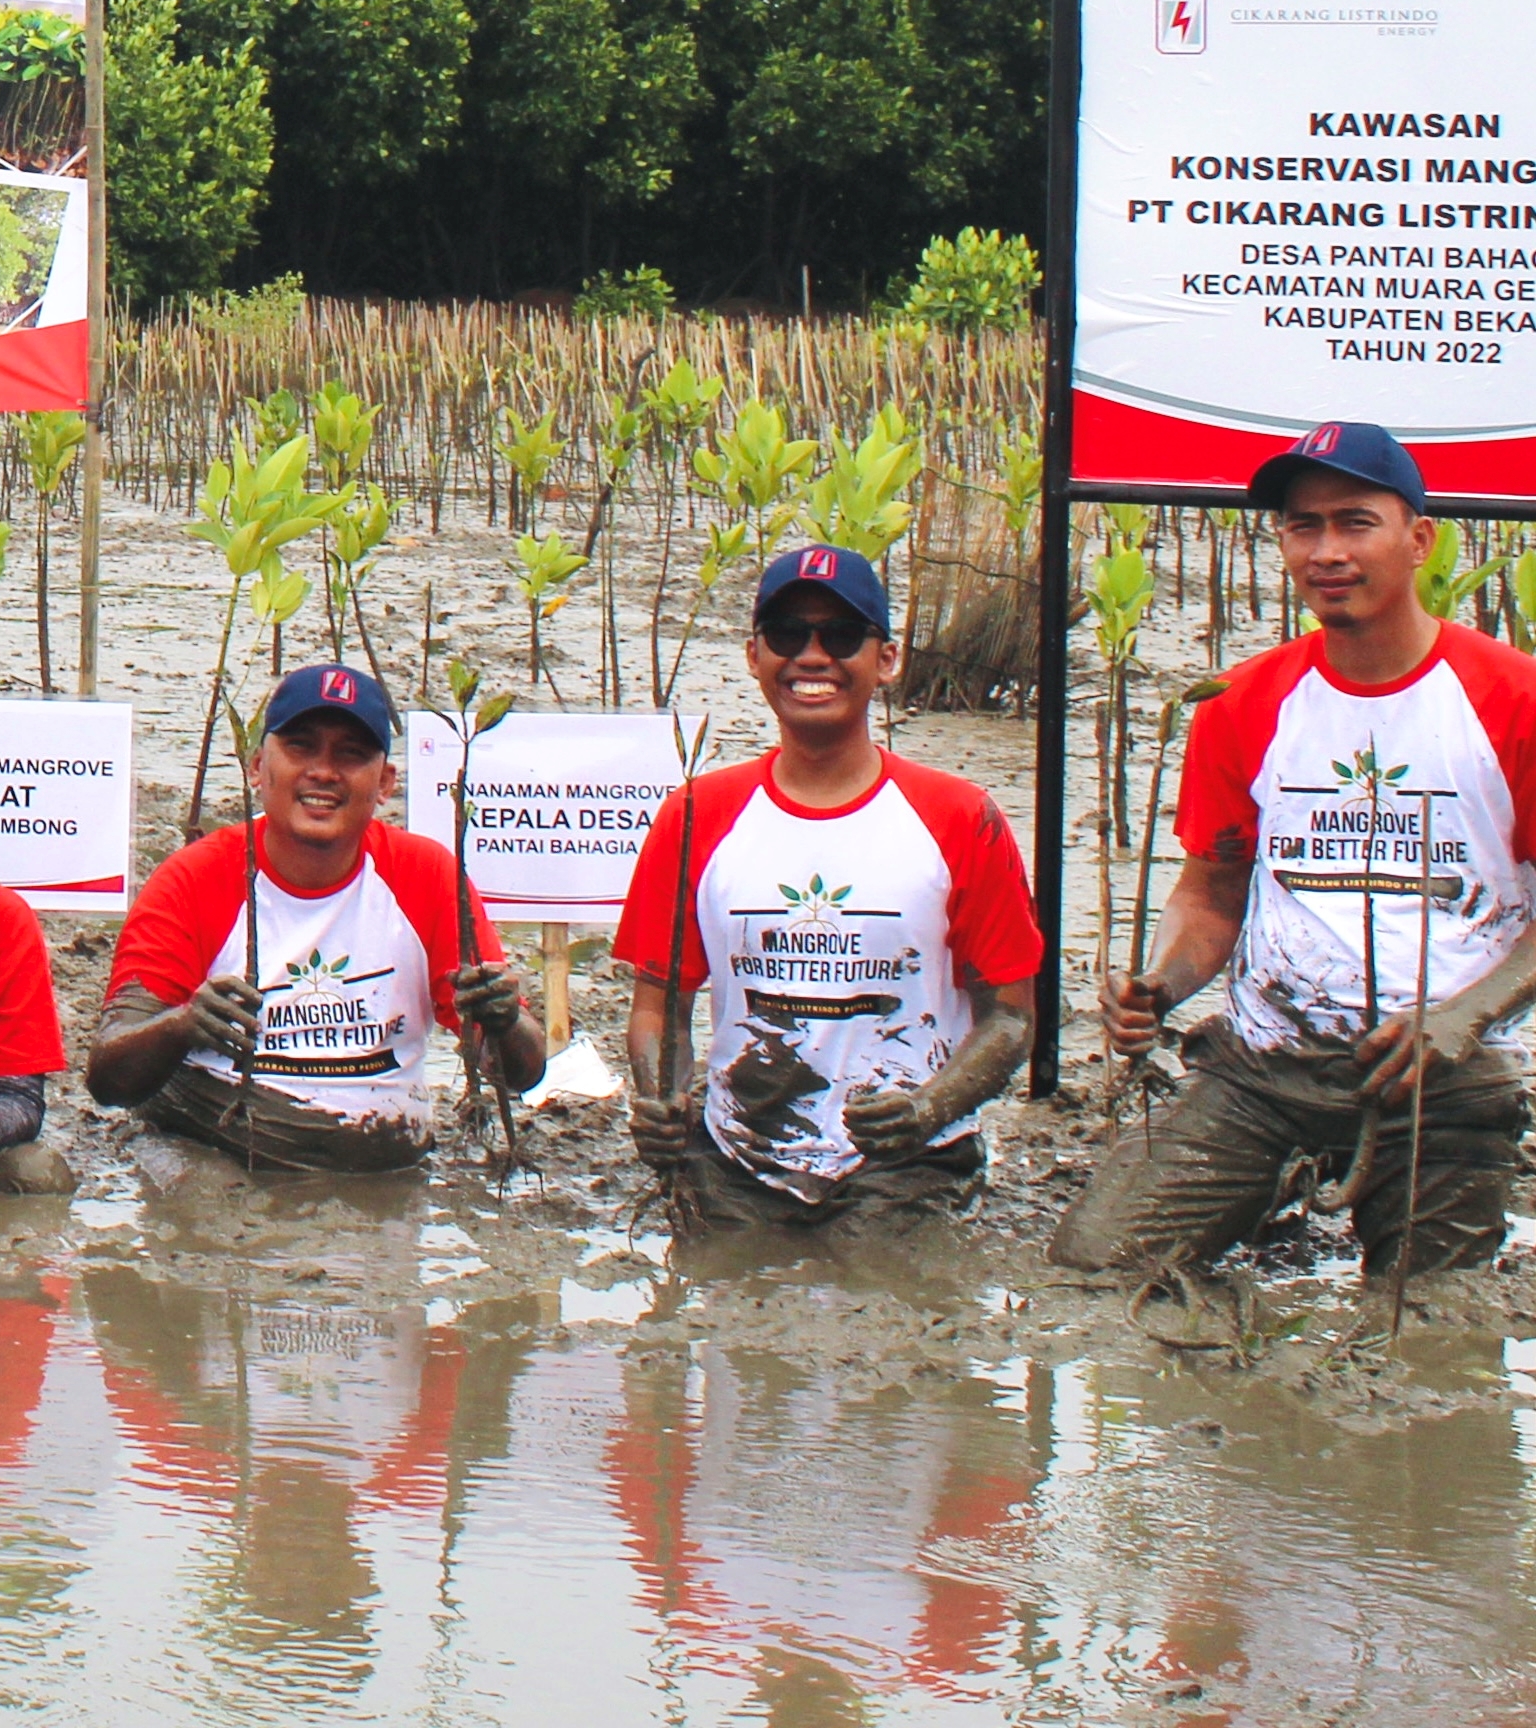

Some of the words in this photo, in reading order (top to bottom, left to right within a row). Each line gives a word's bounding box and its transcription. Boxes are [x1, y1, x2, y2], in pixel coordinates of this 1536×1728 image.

[1230, 10, 1329, 21] CIKARANG
[1338, 10, 1438, 21] LISTRINDO
[1378, 27, 1436, 36] ENERGY
[1309, 113, 1500, 138] KAWASAN
[1171, 156, 1410, 182] KONSERVASI
[1127, 200, 1172, 223] PT
[1186, 201, 1384, 227] CIKARANG
[1241, 244, 1320, 266] DESA
[1330, 245, 1433, 267] PANTAI
[1444, 248, 1536, 270] BAHA
[1182, 275, 1365, 298] KECAMATAN
[1375, 277, 1484, 300] MUARA
[1264, 307, 1443, 330] KABUPATEN
[1326, 339, 1425, 362] TAHUN
[1436, 342, 1501, 364] 2022
[580, 810, 652, 830] DESA
[1310, 810, 1419, 835] MANGROVE
[477, 838, 543, 853] PANTAI
[550, 840, 638, 854] BAHAGIA
[762, 928, 861, 954] MANGROVE
[766, 958, 831, 982] BETTER
[267, 999, 366, 1028] MANGROVE
[265, 1027, 337, 1050] BETTER
